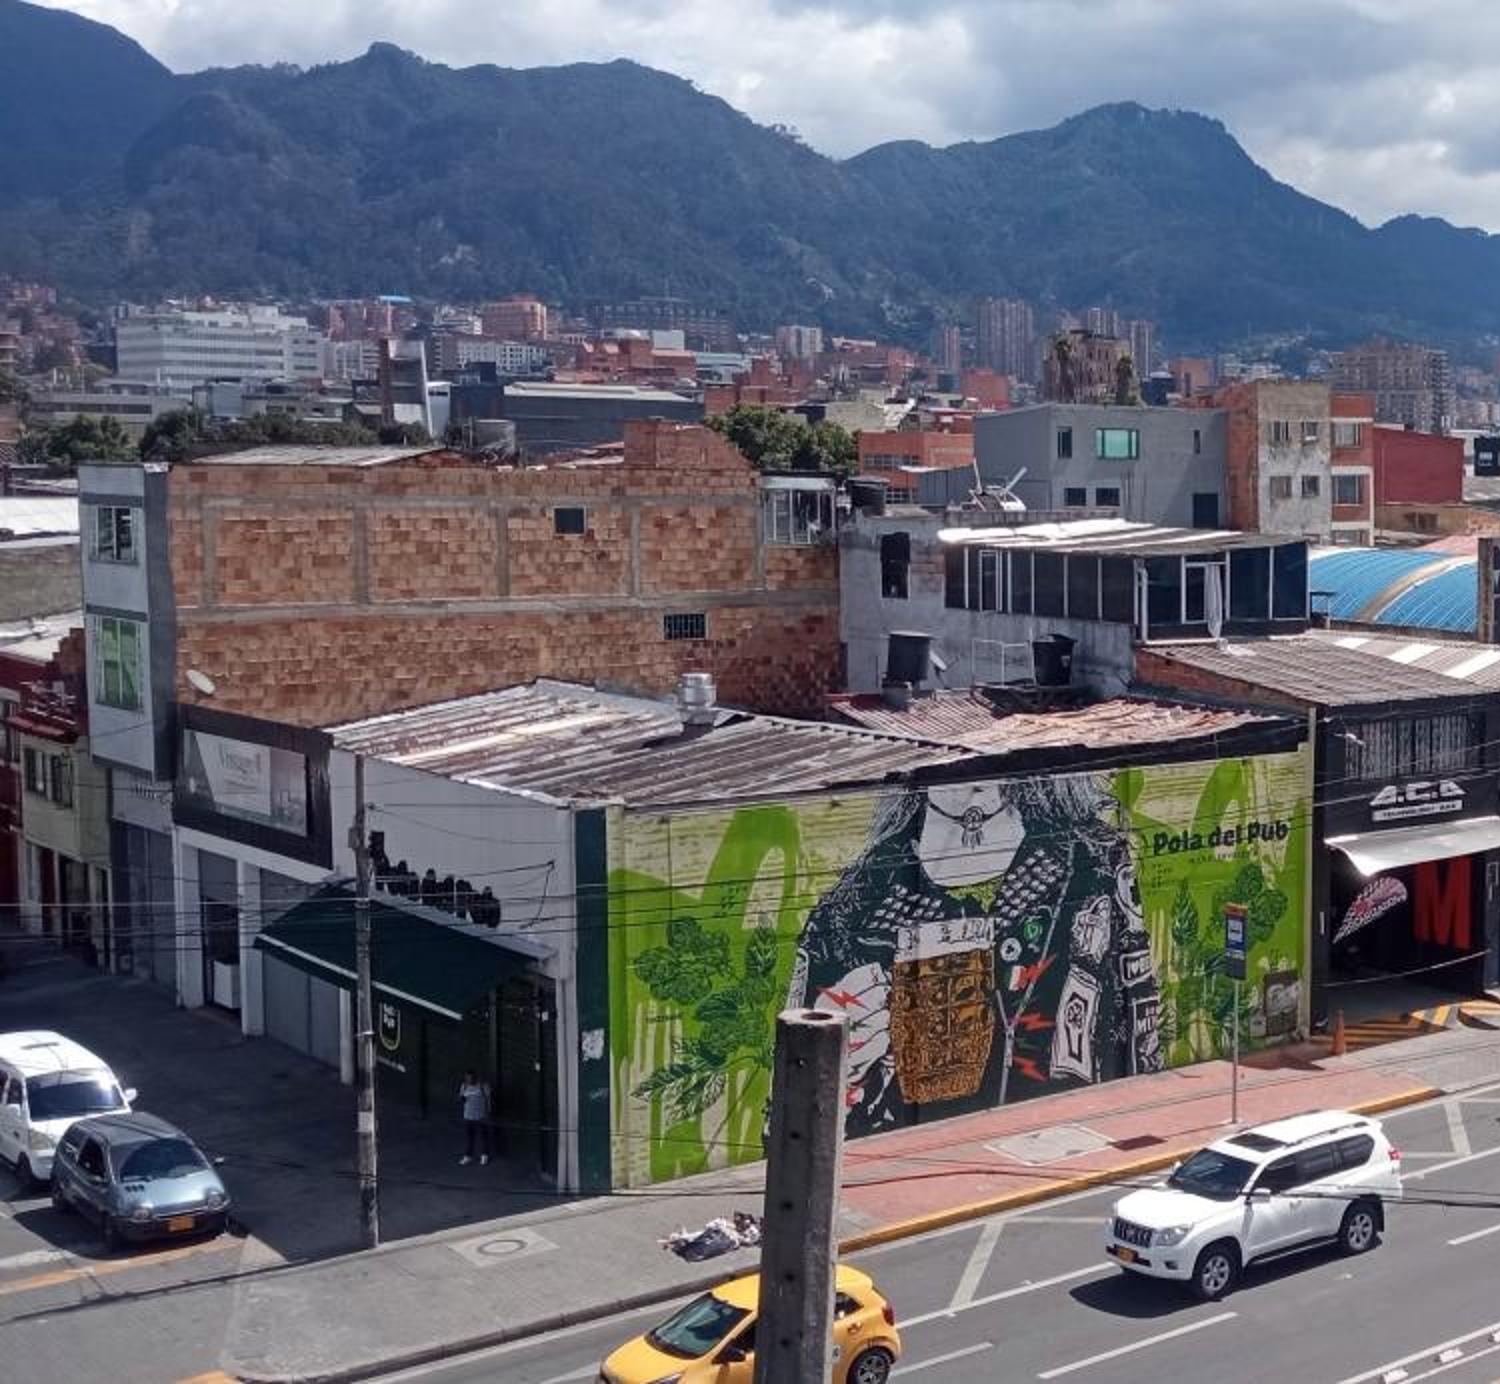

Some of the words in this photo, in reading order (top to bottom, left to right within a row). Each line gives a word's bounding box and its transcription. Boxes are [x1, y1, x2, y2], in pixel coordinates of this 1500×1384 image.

[1153, 829, 1201, 856] Pola
[1208, 825, 1245, 847] del
[1247, 820, 1288, 844] Pub
